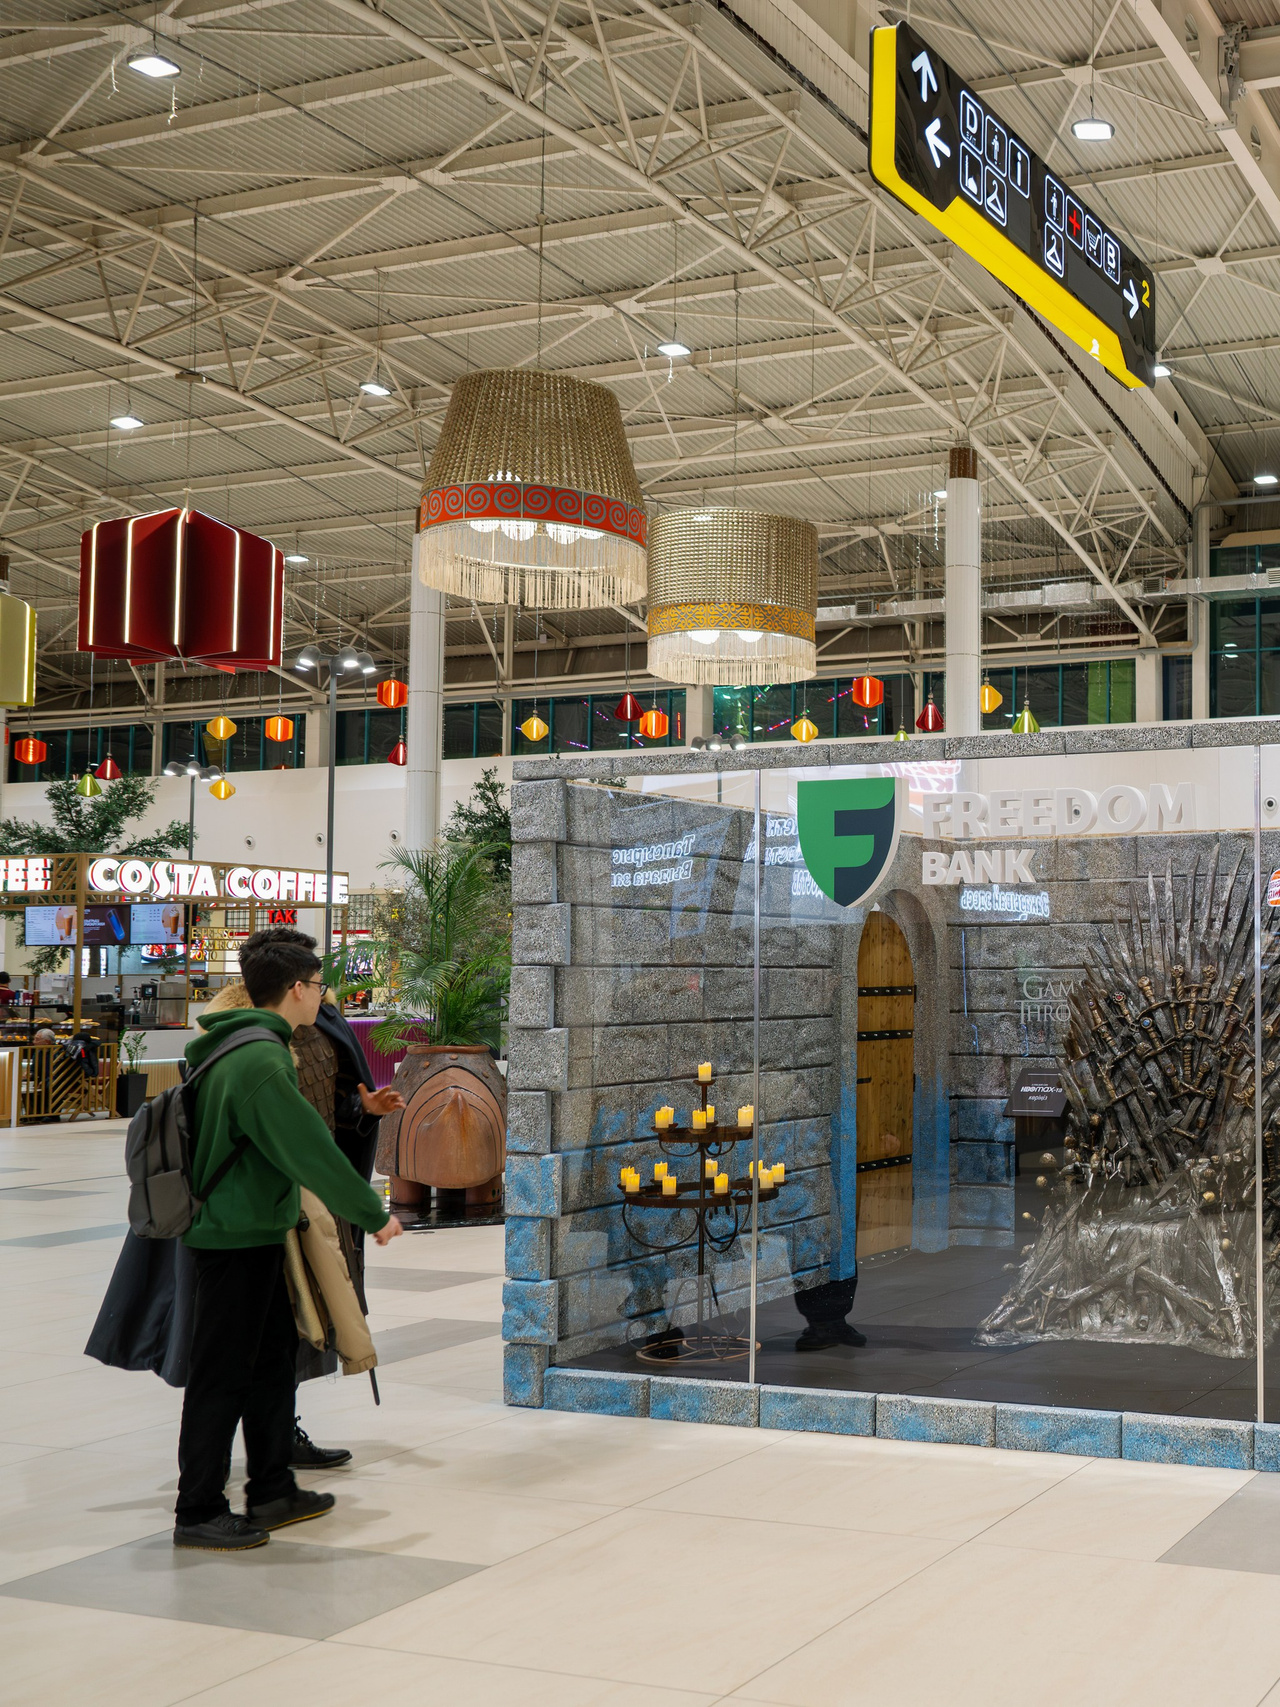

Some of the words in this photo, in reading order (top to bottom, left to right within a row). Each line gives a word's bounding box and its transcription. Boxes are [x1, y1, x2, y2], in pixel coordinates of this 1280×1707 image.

[966, 101, 978, 134] D
[1107, 241, 1116, 269] B
[1141, 279, 1150, 308] 2
[922, 781, 1197, 839] FREEDOM
[88, 858, 218, 899] COSTA
[225, 867, 349, 904] COFFEE
[922, 849, 1036, 885] BANK
[1022, 976, 1077, 1000] GAM
[1014, 1000, 1072, 1025] THRO
